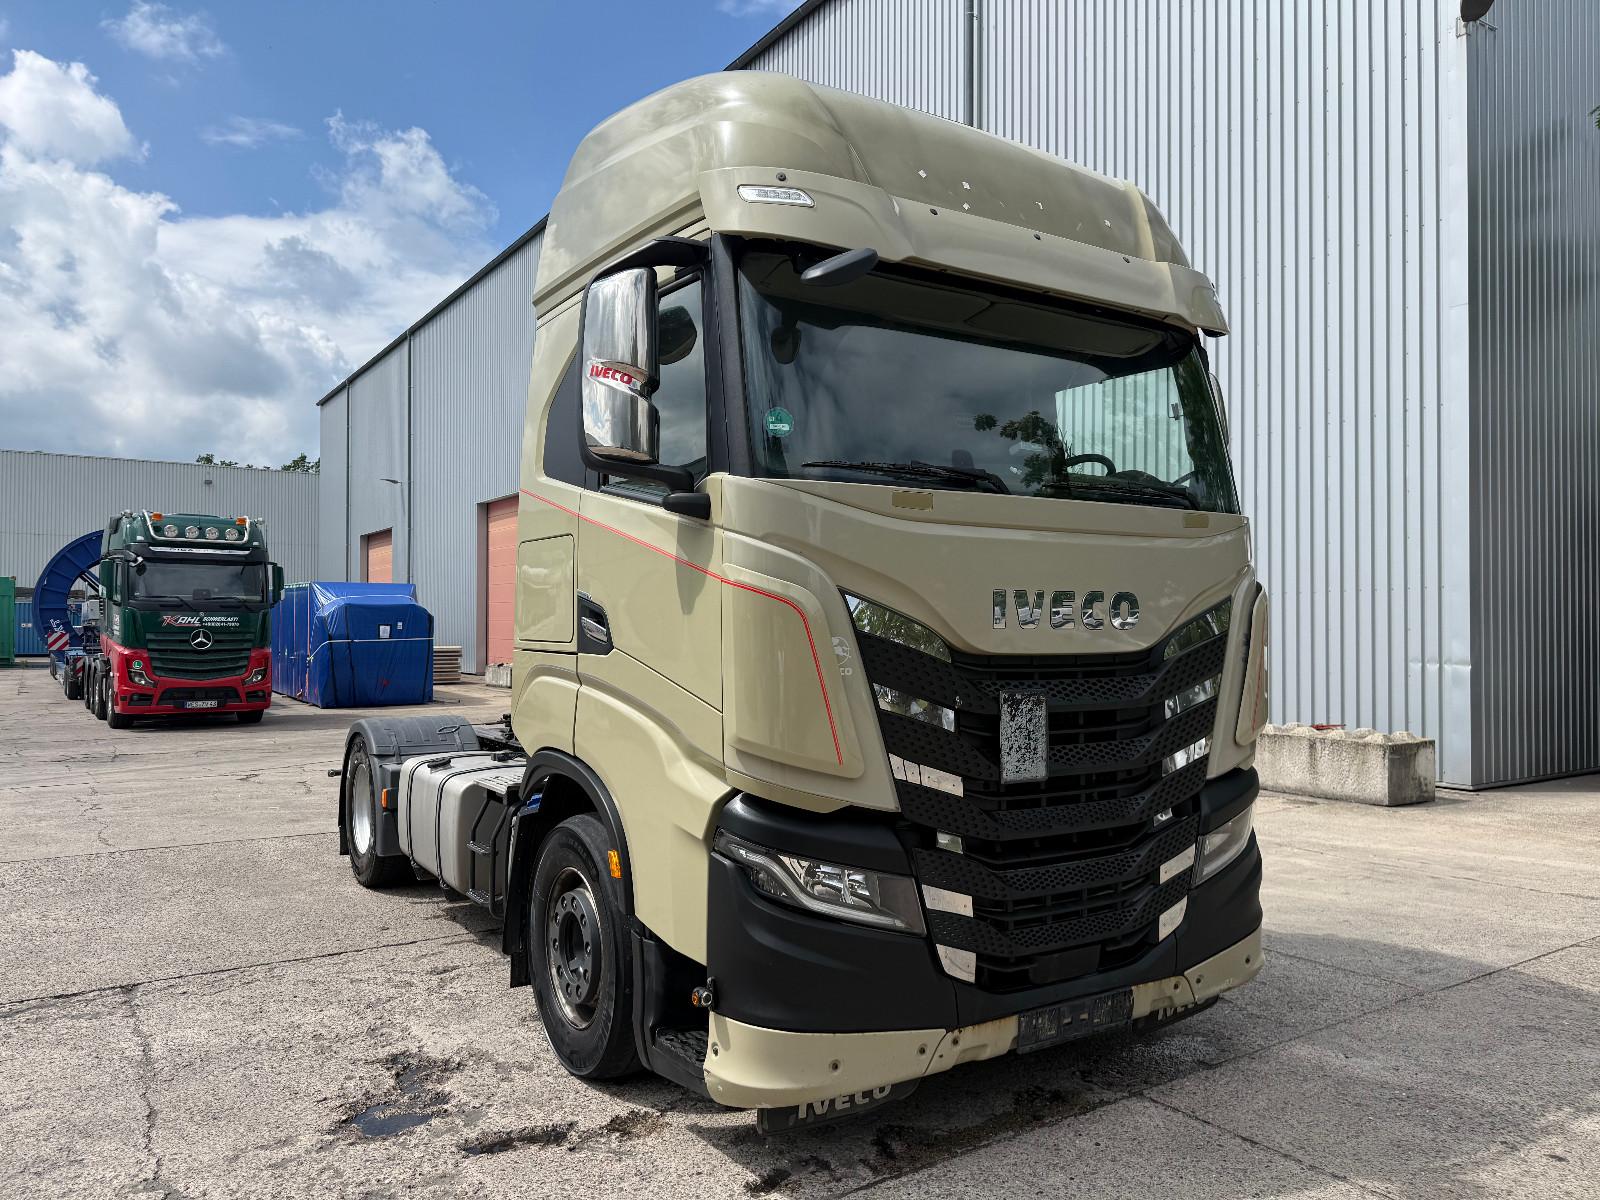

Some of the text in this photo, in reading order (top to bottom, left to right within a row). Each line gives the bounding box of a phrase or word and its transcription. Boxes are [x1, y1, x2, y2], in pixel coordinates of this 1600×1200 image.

[590, 364, 633, 385] IVECO
[993, 588, 1140, 630] IVECO
[162, 615, 201, 627] KAHL
